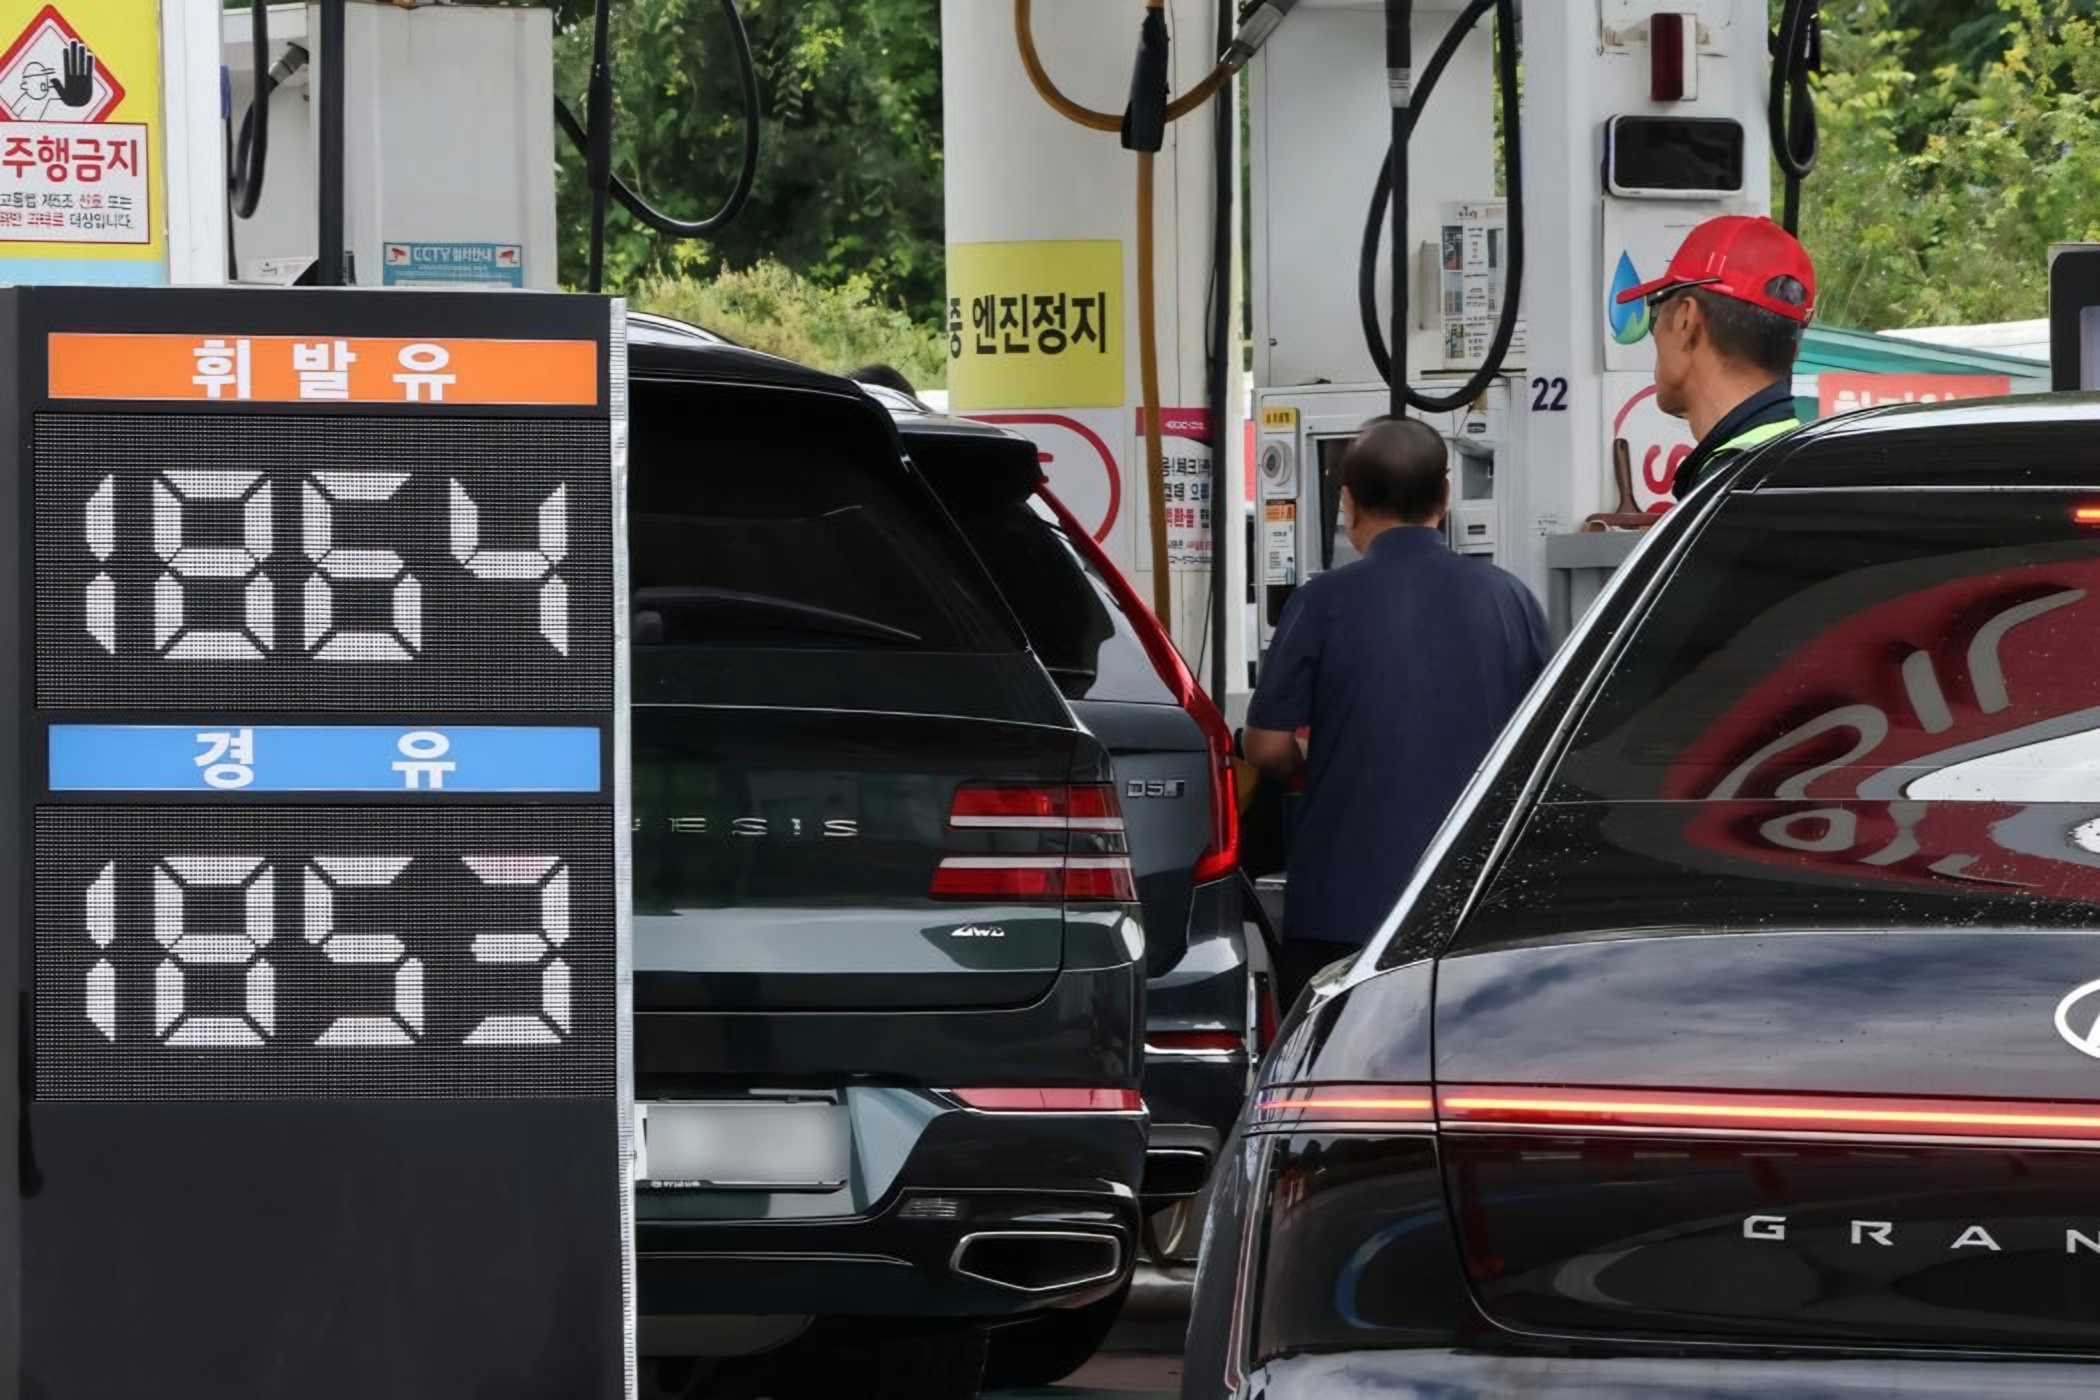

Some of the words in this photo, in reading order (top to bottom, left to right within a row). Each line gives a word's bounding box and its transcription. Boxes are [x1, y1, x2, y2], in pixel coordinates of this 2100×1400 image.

[2, 135, 138, 182] 주행금지
[972, 292, 1106, 355] 엔진정지
[193, 339, 456, 401] 휘발유
[1531, 377, 1568, 411] 22
[86, 470, 568, 660] 1864
[631, 817, 858, 837] ESIS
[86, 856, 570, 1046] 1853
[1743, 1215, 2100, 1254] GRAN
